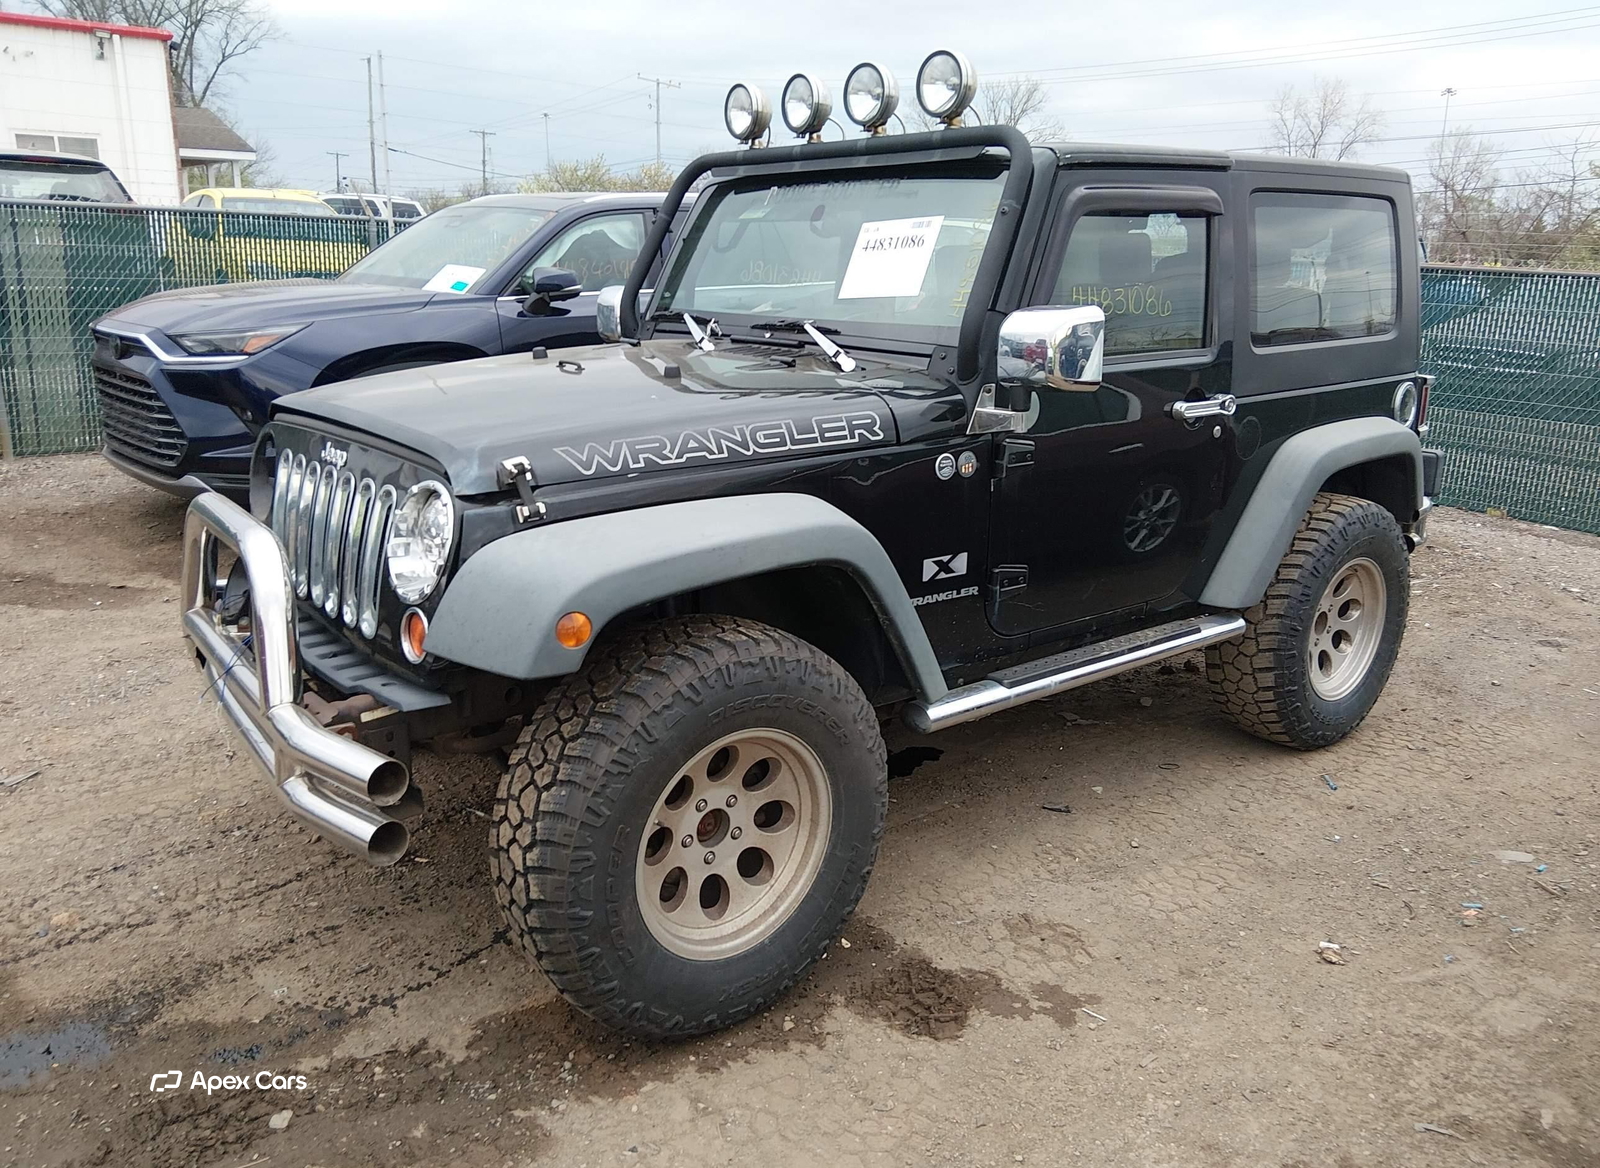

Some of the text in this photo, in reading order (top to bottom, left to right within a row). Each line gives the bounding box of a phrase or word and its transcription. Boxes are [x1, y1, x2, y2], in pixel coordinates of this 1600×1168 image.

[862, 234, 926, 252] 44831086
[1072, 285, 1173, 317] 44831086
[320, 441, 347, 470] Jeep
[553, 410, 885, 476] WRANGLER
[707, 693, 851, 747] DISCOVERER
